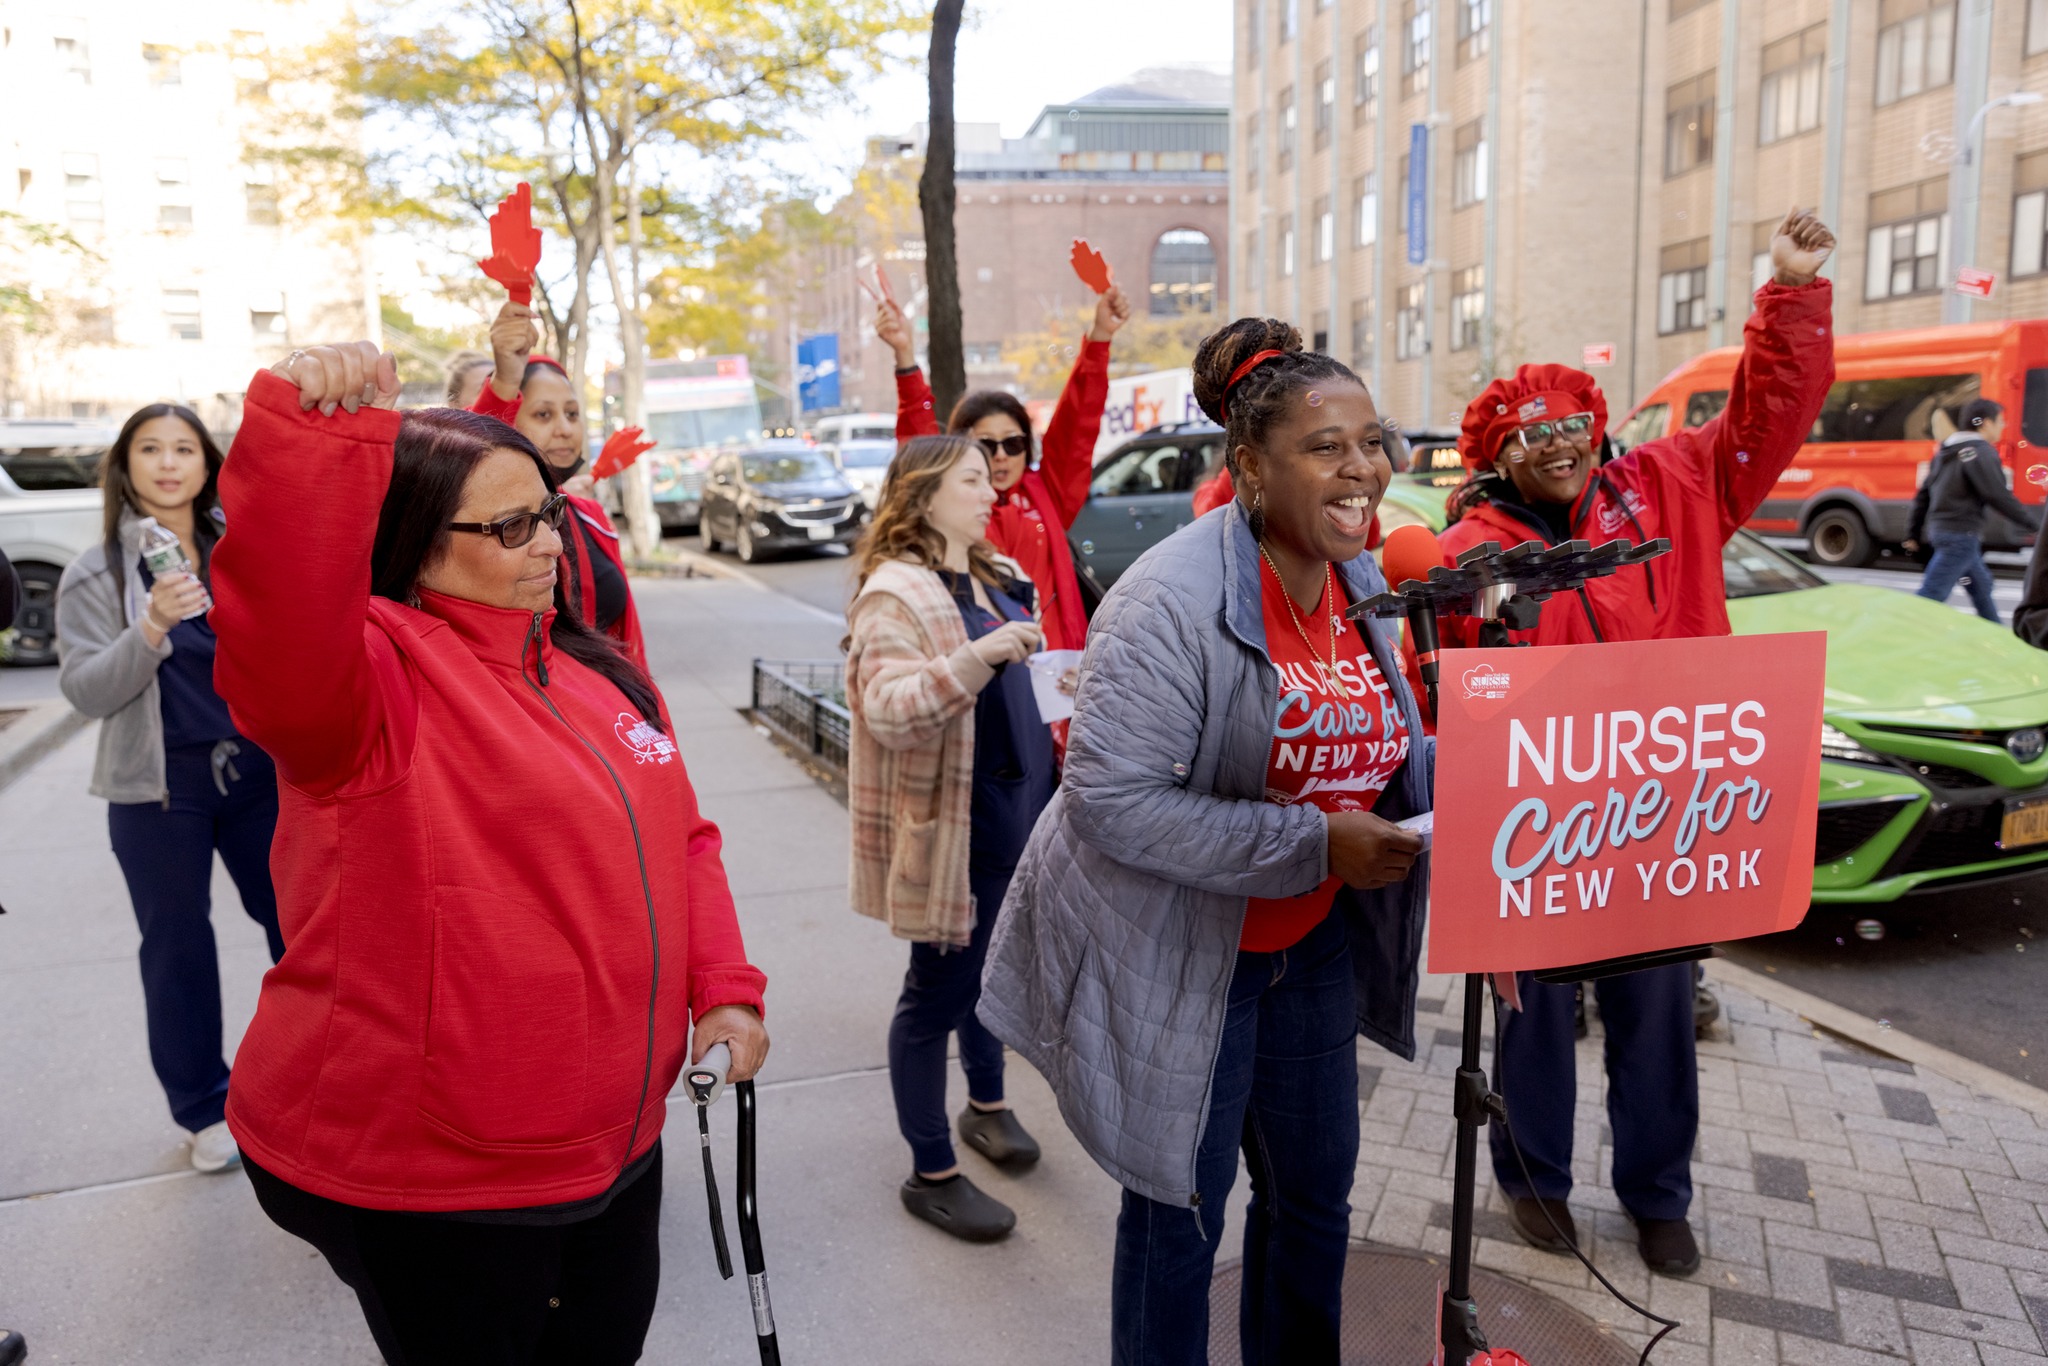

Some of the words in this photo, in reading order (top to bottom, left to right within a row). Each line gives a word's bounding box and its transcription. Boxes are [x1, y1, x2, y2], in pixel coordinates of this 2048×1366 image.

[1104, 386, 1163, 433] edEx
[1272, 652, 1389, 699] NURSE
[1471, 676, 1510, 687] NURSES
[1274, 690, 1373, 740] Care
[1275, 743, 1358, 773] NEW
[1365, 736, 1410, 765] YOR
[1507, 700, 1766, 788] NURSES
[1491, 778, 1671, 882] Care
[1673, 766, 1770, 856] for
[1499, 866, 1614, 919] NEW
[1635, 848, 1762, 901] YORK
